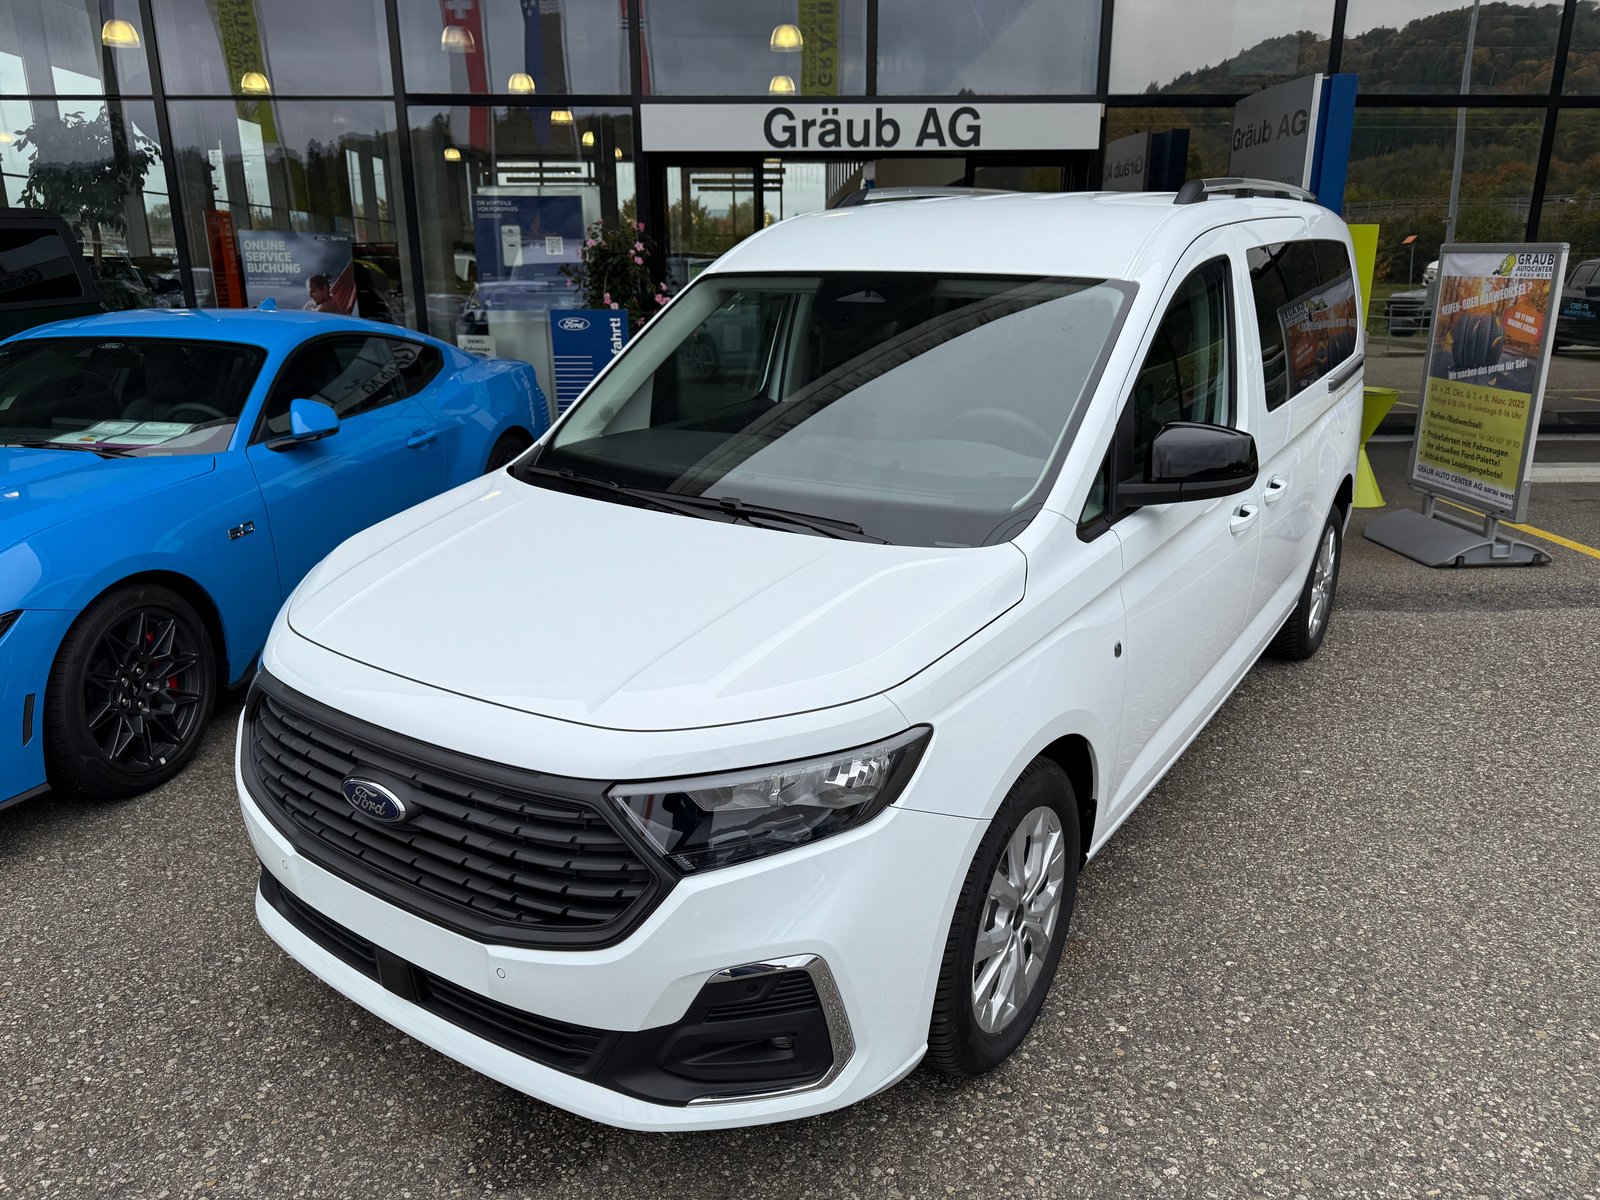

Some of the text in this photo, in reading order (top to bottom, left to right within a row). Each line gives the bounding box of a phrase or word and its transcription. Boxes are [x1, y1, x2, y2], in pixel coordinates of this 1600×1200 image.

[764, 107, 982, 149] Gräub AG
[1233, 109, 1307, 152] Gräub AG
[244, 240, 286, 251] ONLINE
[245, 251, 292, 262] SERVICE
[247, 262, 301, 274] BUCHUNG
[1516, 265, 1553, 273] AUTOCENTER
[1462, 296, 1479, 310] ODER
[1477, 365, 1488, 375] das
[1505, 360, 1515, 371] für
[1515, 358, 1528, 369] Sie!
[1452, 388, 1465, 398] Okt.
[1491, 395, 1507, 407] Nov.
[1507, 398, 1525, 409] 2025
[1510, 410, 1523, 420] Uhr
[1426, 441, 1501, 467] der aktuellen Ford-Palette!
[1427, 430, 1509, 458] Probefahrten mit Fahrzeugen
[1424, 451, 1504, 480] Attraktive Leasingangebote!
[1435, 470, 1451, 481] AUTO
[1451, 475, 1473, 488] CENTER
[1473, 481, 1484, 492] AG
[1499, 491, 1515, 501] west
[351, 785, 387, 816] Ford
